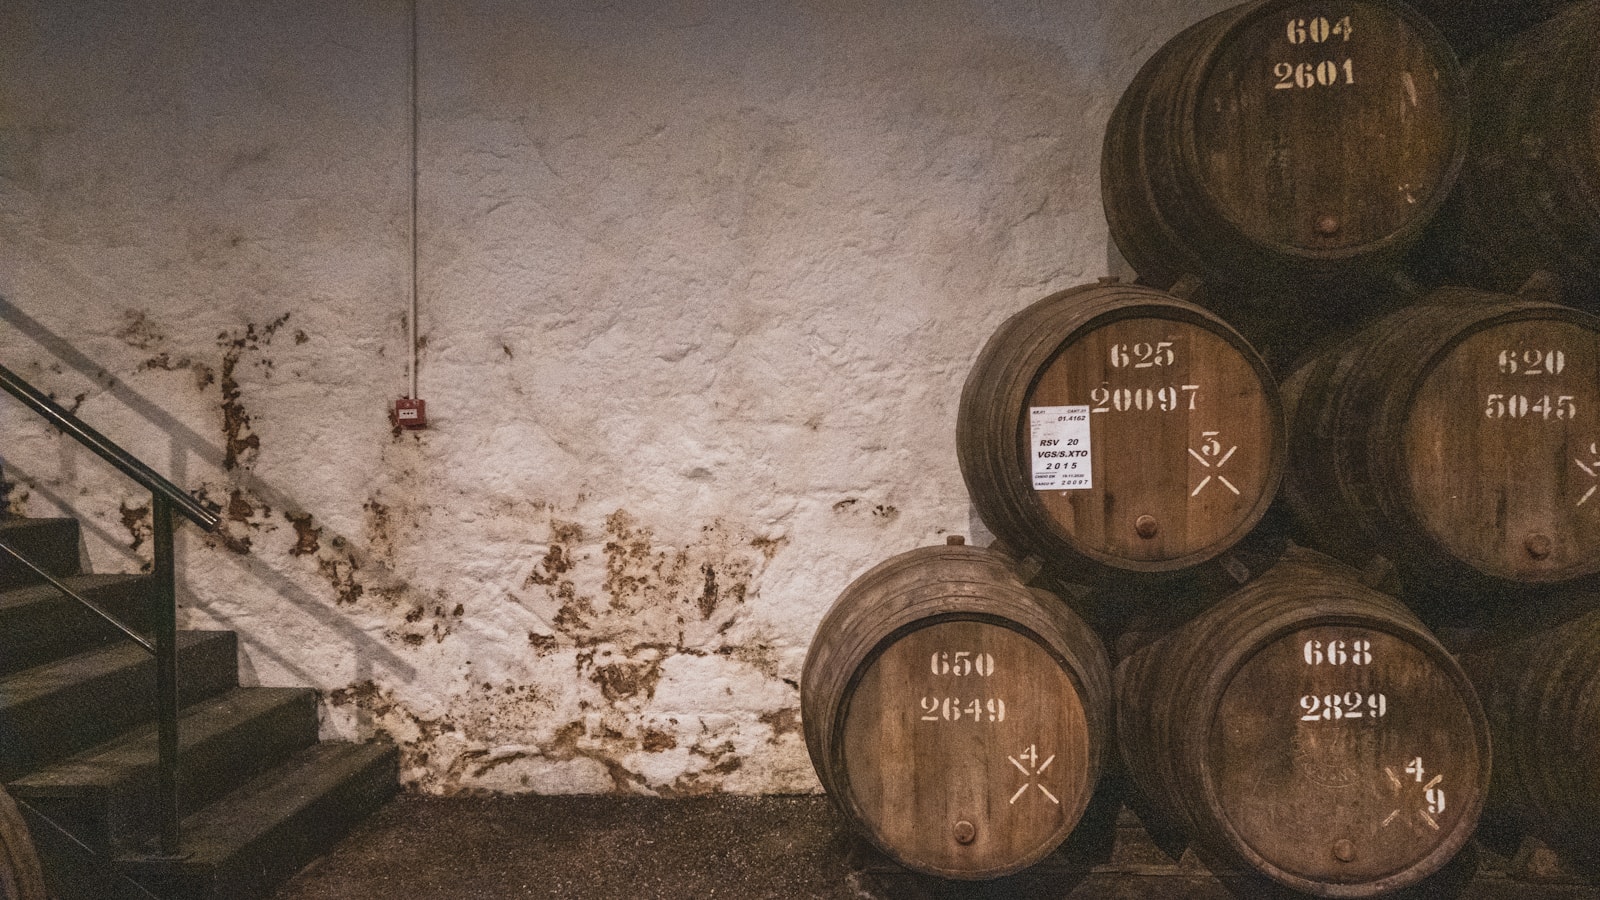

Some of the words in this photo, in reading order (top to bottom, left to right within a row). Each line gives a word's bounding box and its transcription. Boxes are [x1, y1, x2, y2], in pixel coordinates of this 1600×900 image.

[1286, 16, 1354, 45] 604
[1273, 58, 1355, 90] 2601
[1110, 342, 1175, 368] 625
[1498, 349, 1565, 375] 620
[1090, 384, 1200, 413] 20097
[1485, 394, 1576, 420] 5045
[1038, 450, 1088, 458] VGS/S.XTO
[1040, 439, 1060, 447] RSV
[1067, 438, 1079, 446] 20
[1201, 431, 1221, 456] 5
[930, 651, 995, 677] 650
[1303, 639, 1373, 666] 668
[920, 696, 1006, 722] 2649
[1300, 691, 1387, 721] 2829
[1019, 743, 1038, 768] 4
[1405, 756, 1425, 782] 4
[1425, 788, 1446, 814] 9
